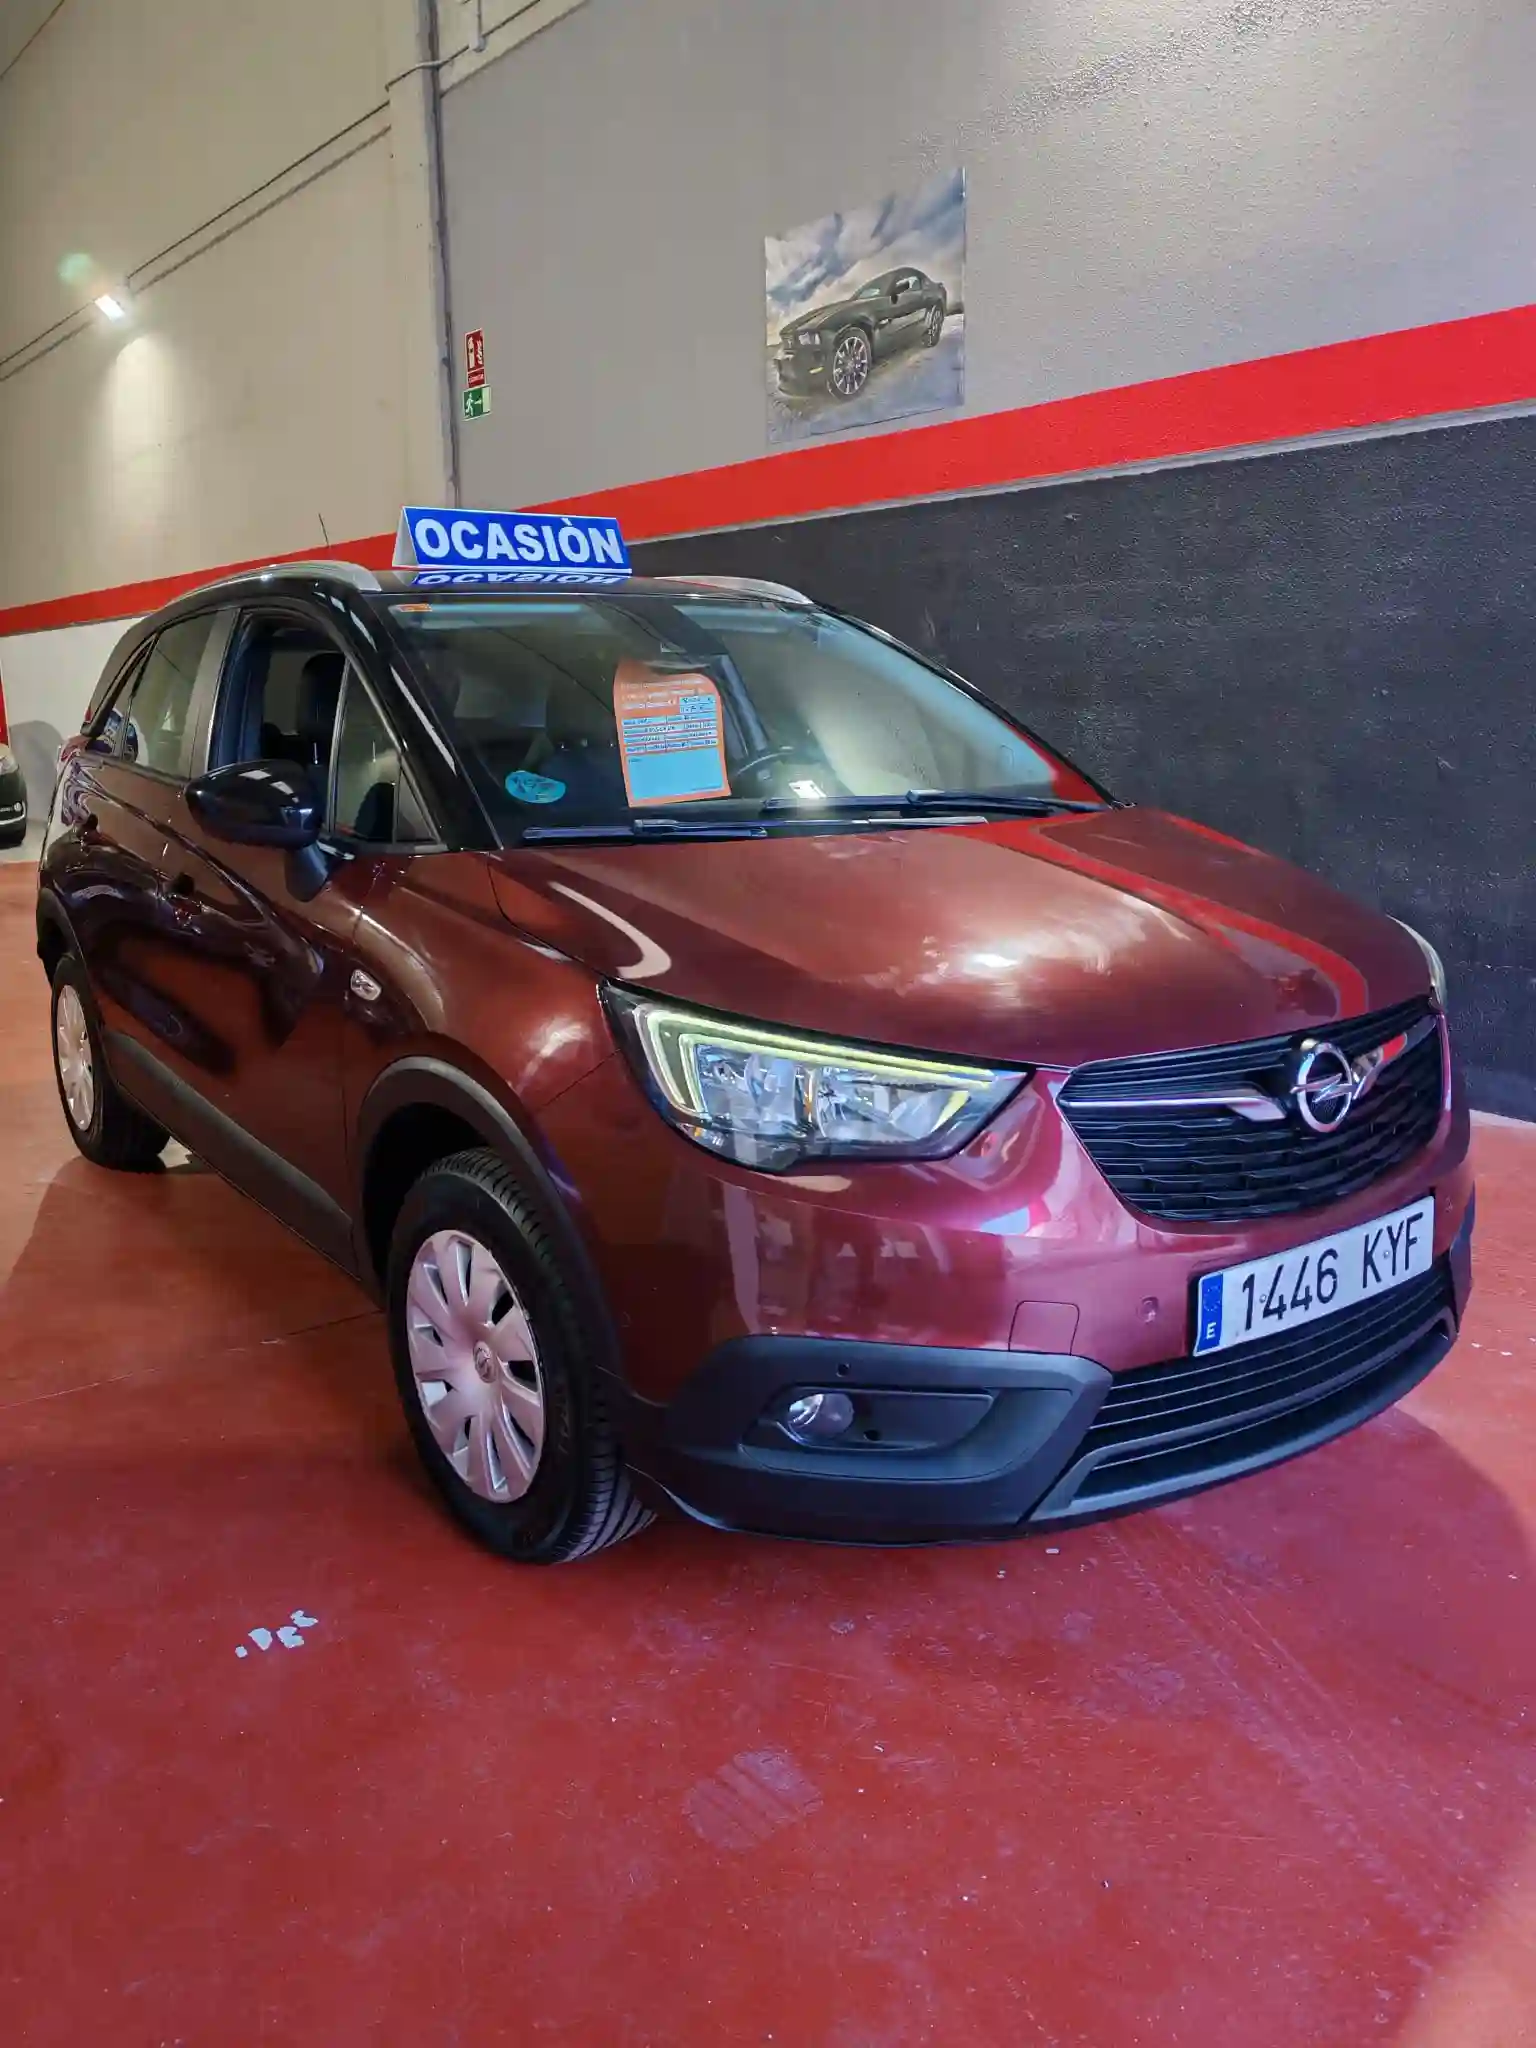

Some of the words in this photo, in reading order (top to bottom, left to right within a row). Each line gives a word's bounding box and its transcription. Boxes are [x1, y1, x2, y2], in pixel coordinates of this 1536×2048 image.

[415, 518, 624, 563] OCASIÒN
[1242, 1248, 1338, 1330] 1446
[1362, 1212, 1424, 1288] KYF
[1206, 1321, 1217, 1340] E
